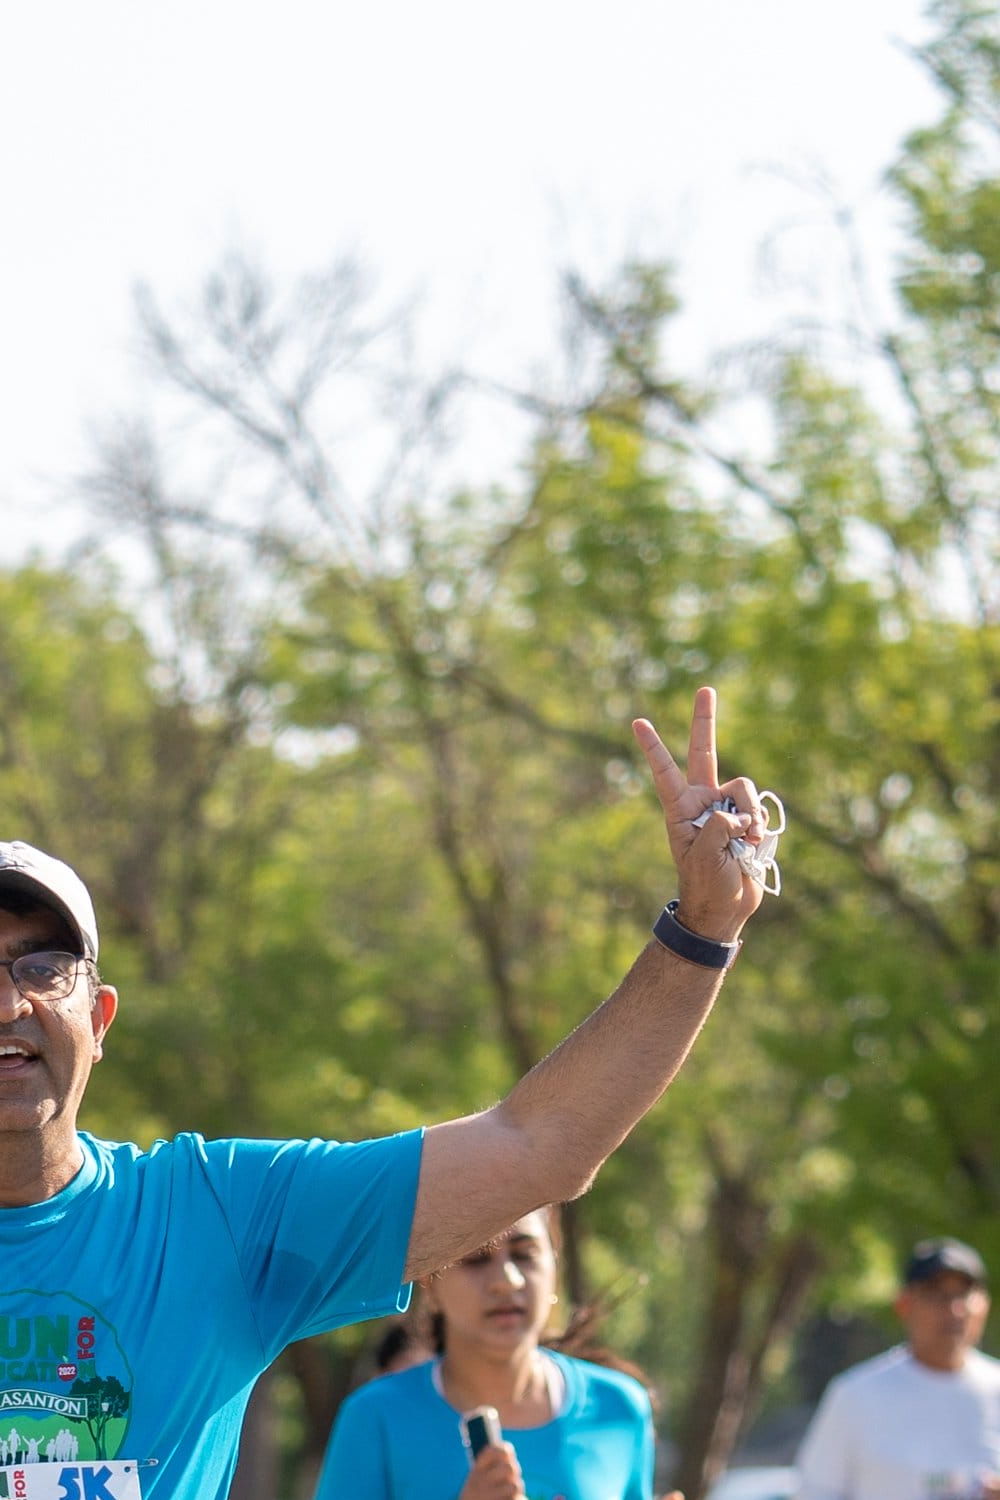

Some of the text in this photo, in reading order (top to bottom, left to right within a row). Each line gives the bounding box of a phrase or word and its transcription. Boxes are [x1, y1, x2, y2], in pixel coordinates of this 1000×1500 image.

[77, 1316, 96, 1360] FOR
[58, 1366, 76, 1376] 2022
[14, 1470, 26, 1498] FOR
